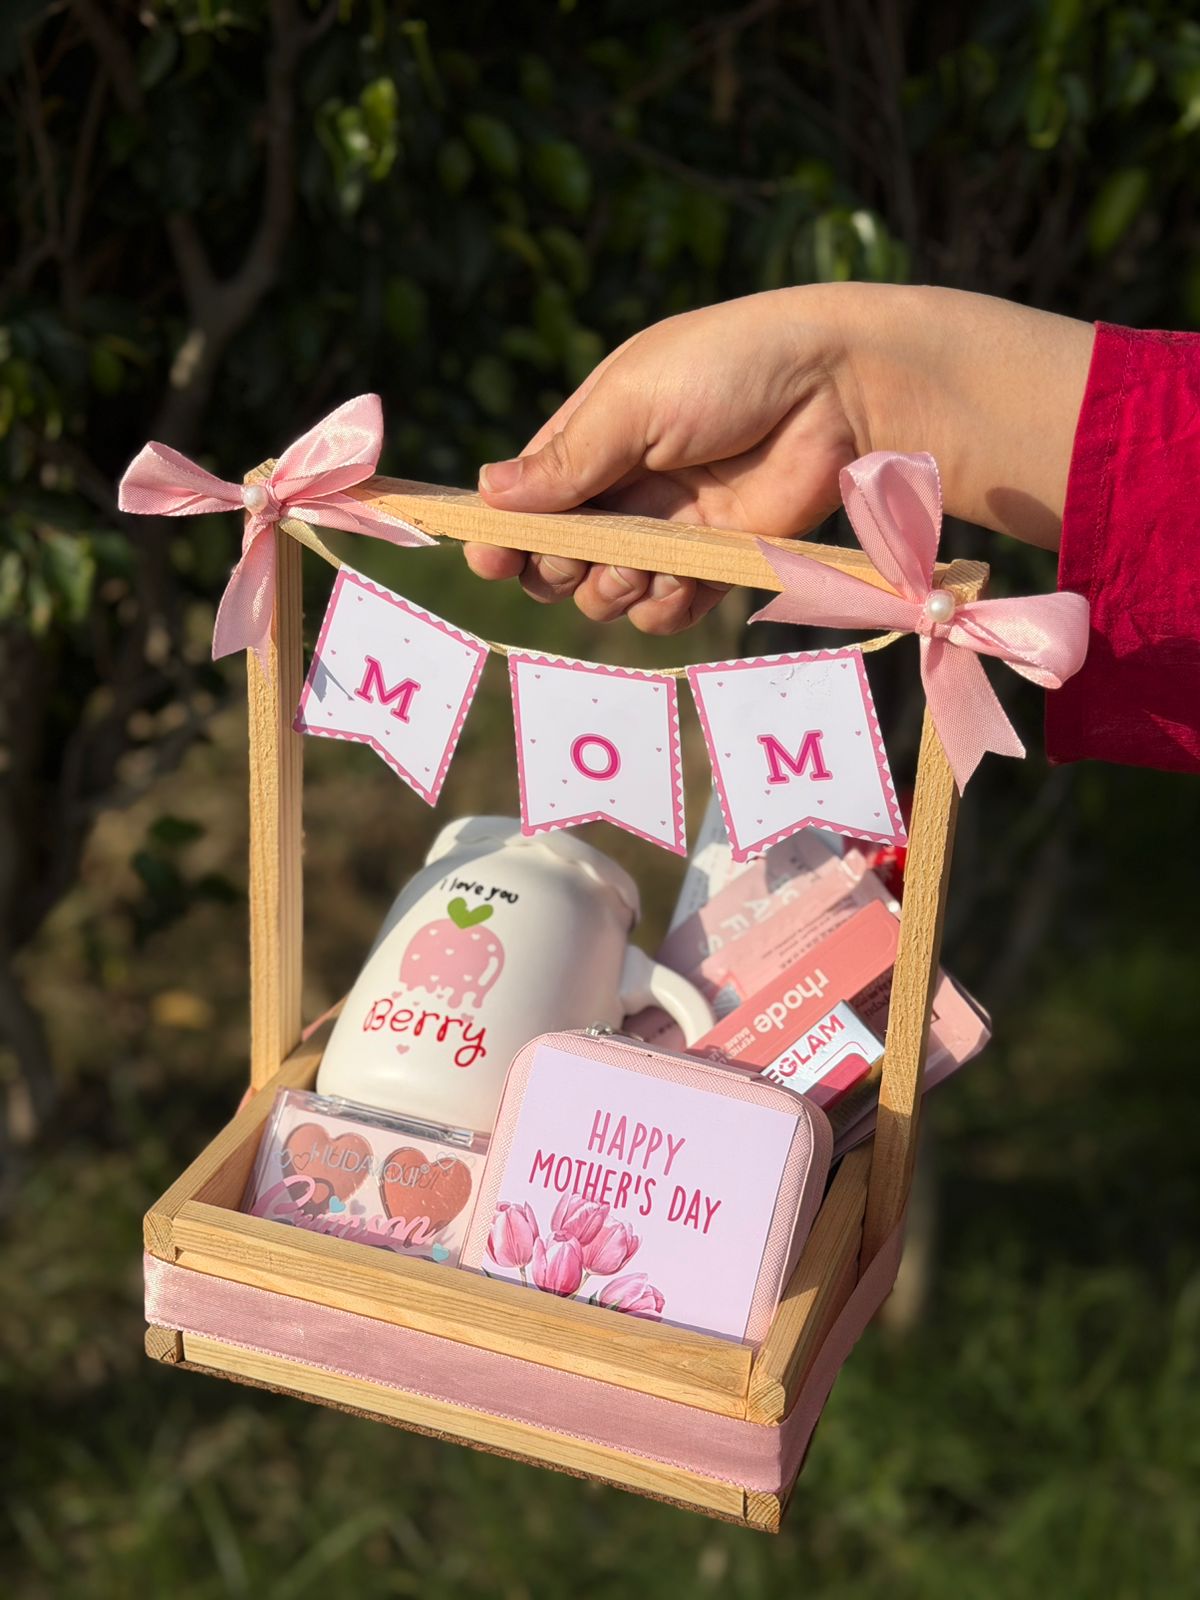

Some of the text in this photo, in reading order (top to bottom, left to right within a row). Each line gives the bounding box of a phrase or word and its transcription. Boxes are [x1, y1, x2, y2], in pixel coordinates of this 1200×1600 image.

[449, 877, 483, 896] love
[484, 885, 520, 904] you
[363, 999, 487, 1068] Berry
[752, 968, 830, 1034] rhode
[587, 1109, 686, 1176] HAPPY
[528, 1149, 722, 1234] MOTHER'S DAY
